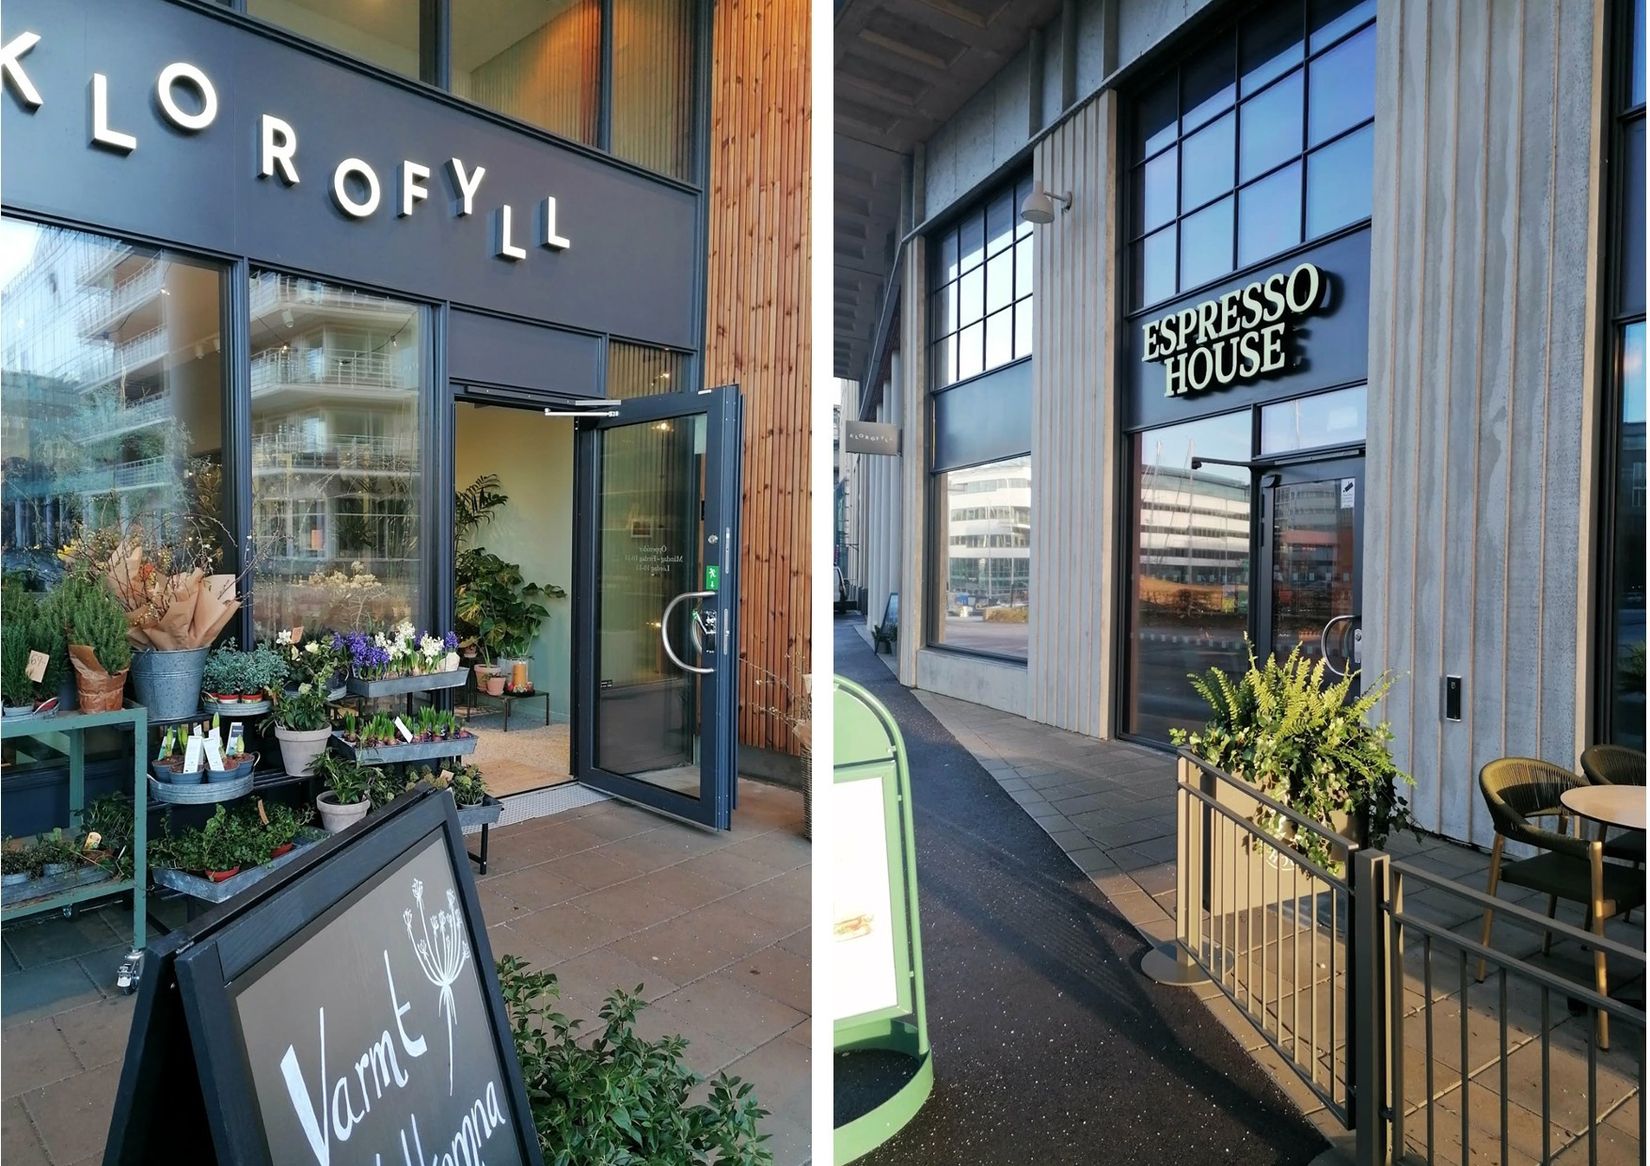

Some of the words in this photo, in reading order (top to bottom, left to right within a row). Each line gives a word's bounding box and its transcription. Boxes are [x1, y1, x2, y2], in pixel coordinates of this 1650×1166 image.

[2, 31, 570, 260] KLOROFYLL
[1141, 262, 1320, 362] ESPRESSO
[1164, 322, 1286, 397] HOUSE
[280, 949, 428, 1166] Varmt
